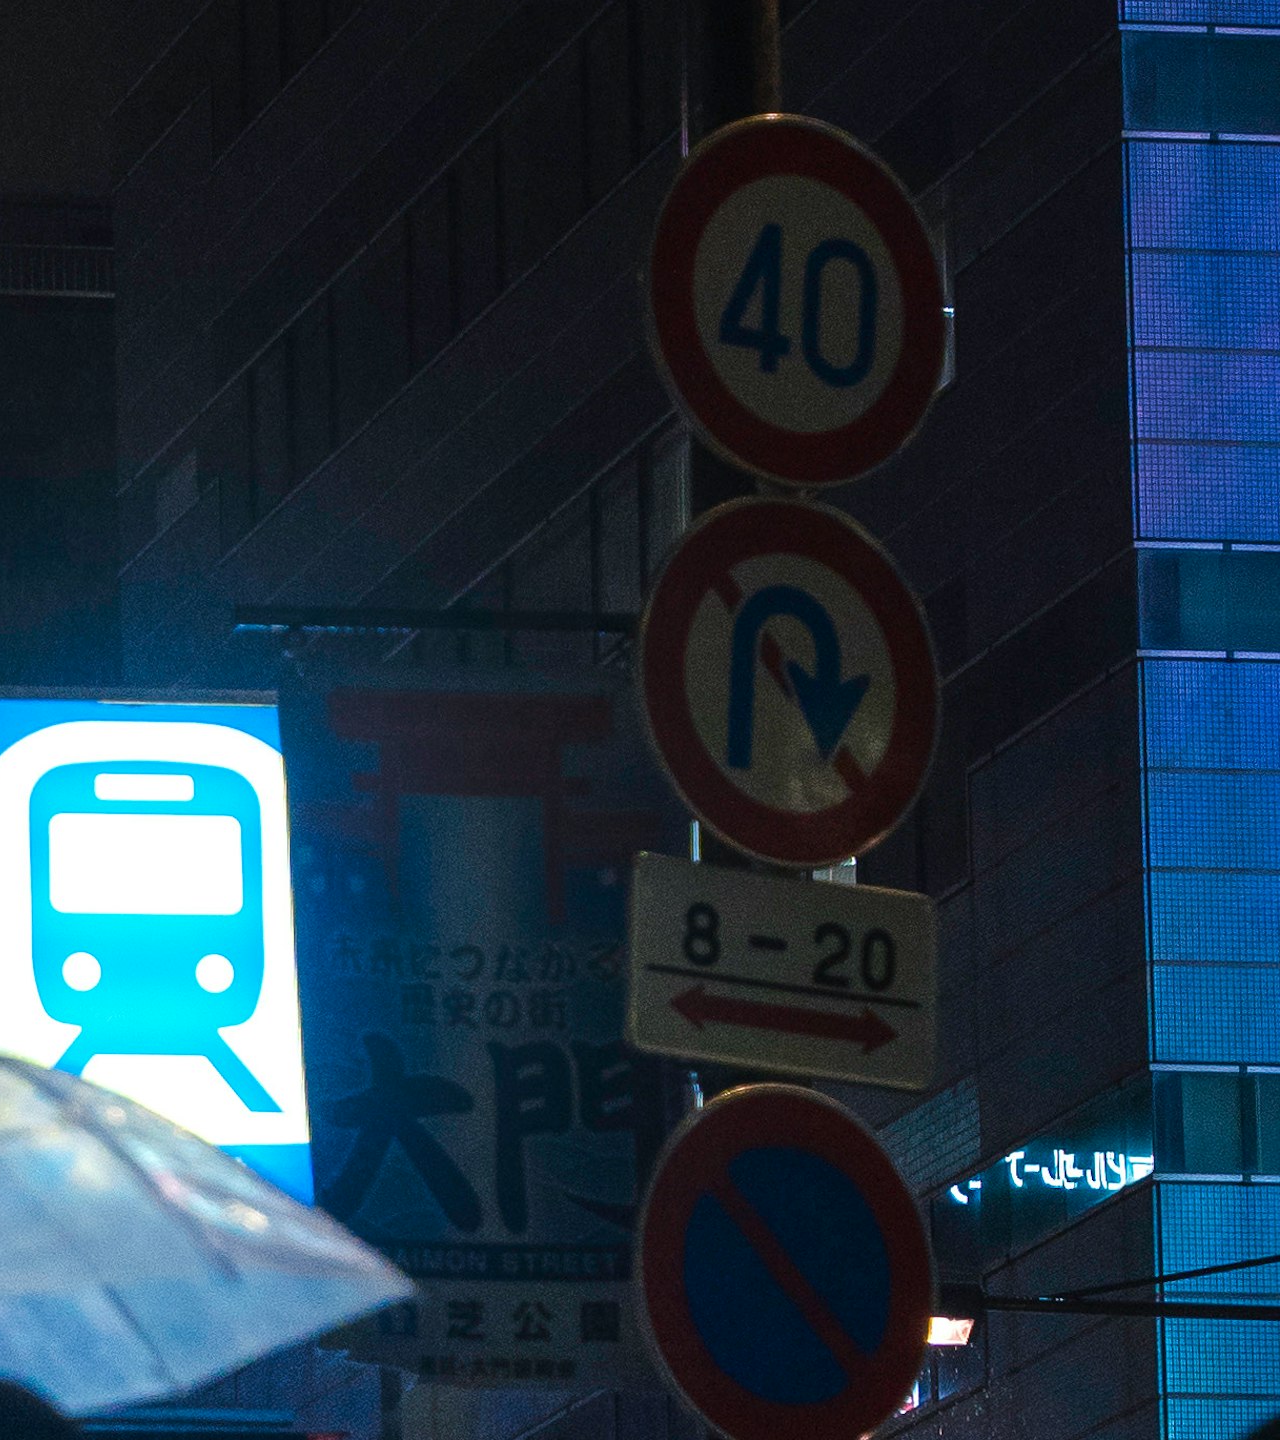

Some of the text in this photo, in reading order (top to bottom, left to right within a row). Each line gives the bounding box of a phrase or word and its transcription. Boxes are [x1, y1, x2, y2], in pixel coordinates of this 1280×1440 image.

[720, 224, 877, 387] 40
[401, 984, 568, 1029] 歴史の街
[320, 1030, 640, 1235] 大門
[392, 1247, 622, 1275] AIMON STREET
